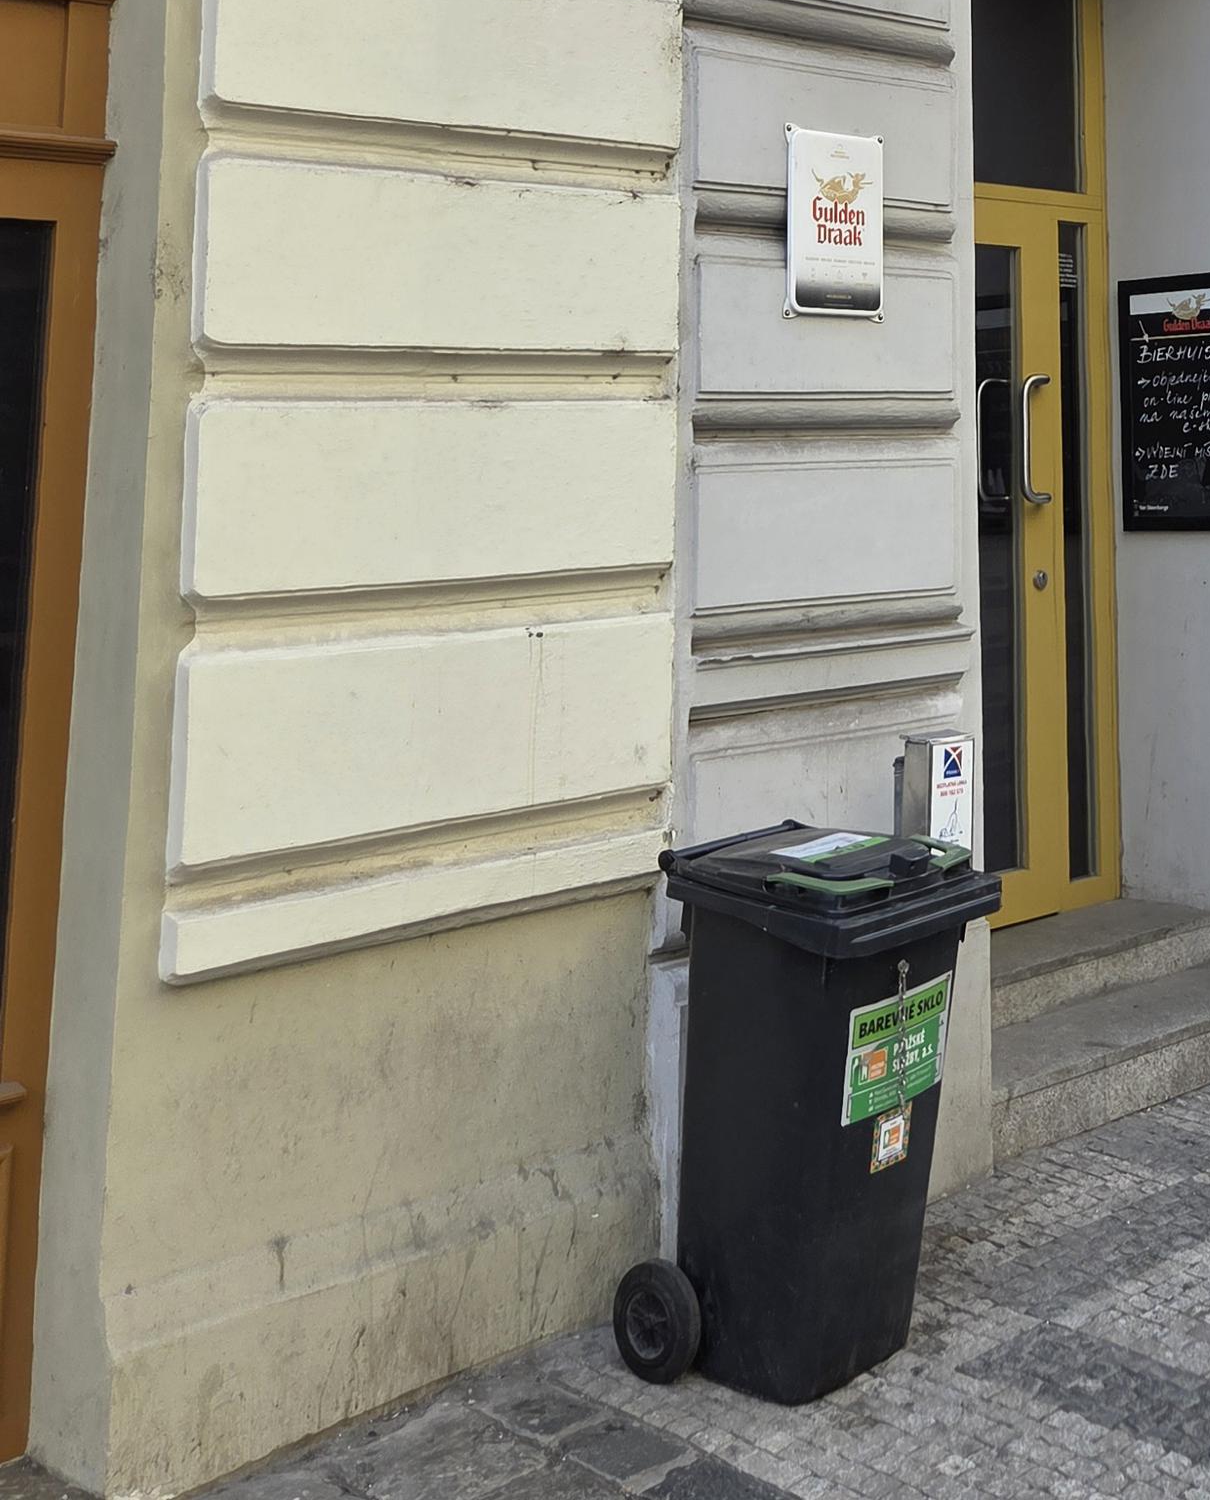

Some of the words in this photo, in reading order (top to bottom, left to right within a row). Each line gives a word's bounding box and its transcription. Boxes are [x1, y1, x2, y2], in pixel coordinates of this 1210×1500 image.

[812, 196, 865, 226] Gulden
[817, 224, 863, 246] Draak
[1140, 411, 1163, 422] na
[1145, 463, 1179, 480] ZDE
[916, 990, 944, 1016] SKLO
